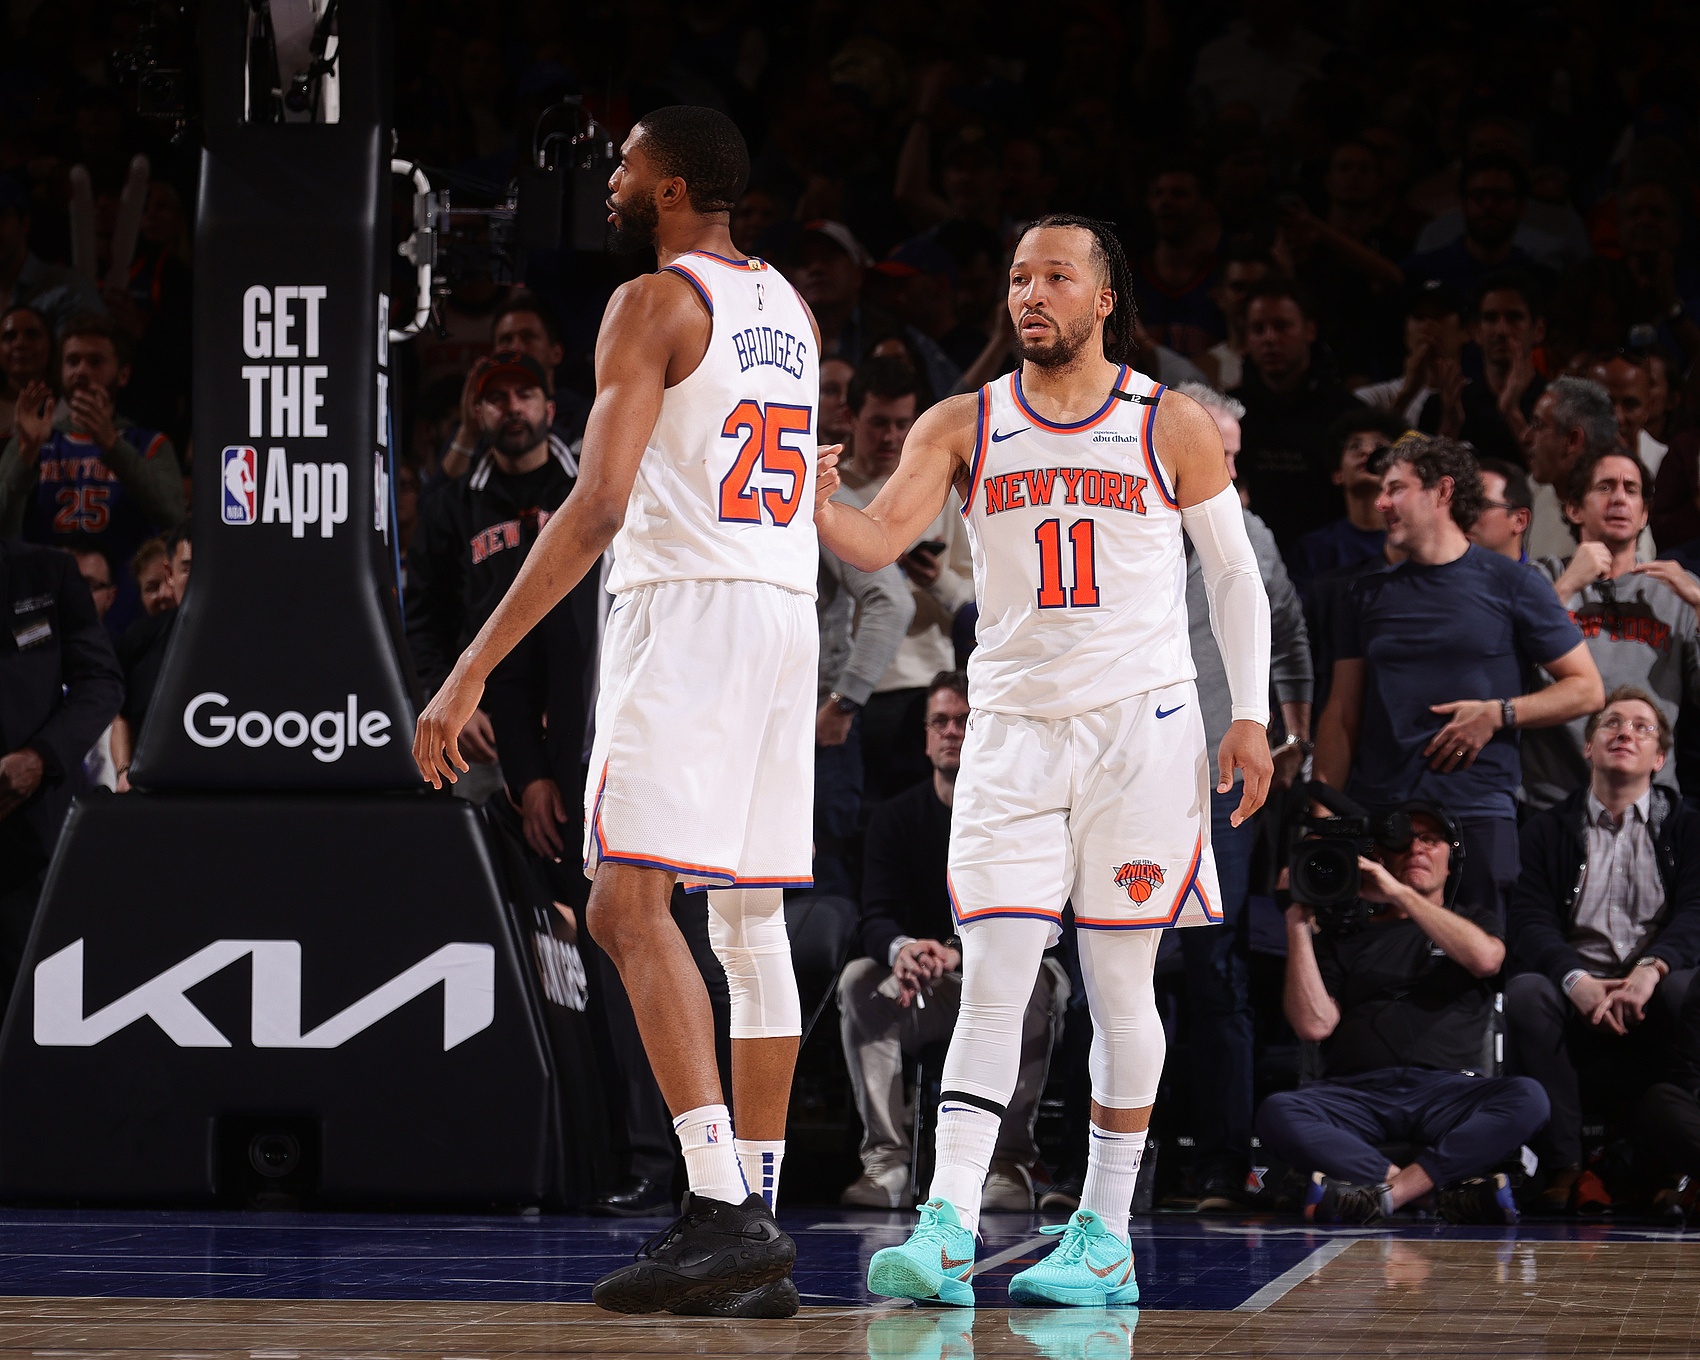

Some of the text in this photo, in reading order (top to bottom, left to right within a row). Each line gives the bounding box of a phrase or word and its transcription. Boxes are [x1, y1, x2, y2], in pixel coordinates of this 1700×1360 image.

[243, 285, 327, 358] GET
[732, 327, 806, 379] BRIDGES
[242, 365, 328, 437] THE
[1131, 394, 1141, 403] 12
[262, 447, 348, 538] App
[719, 399, 812, 527] 25
[985, 468, 1148, 517] NEW YORK
[53, 485, 111, 533] 25
[226, 505, 245, 519] NBA
[470, 519, 521, 565] NEW
[1035, 518, 1101, 609] 11
[184, 692, 392, 762] Google
[1114, 862, 1165, 885] KNICKS
[34, 938, 495, 1051] KIA
